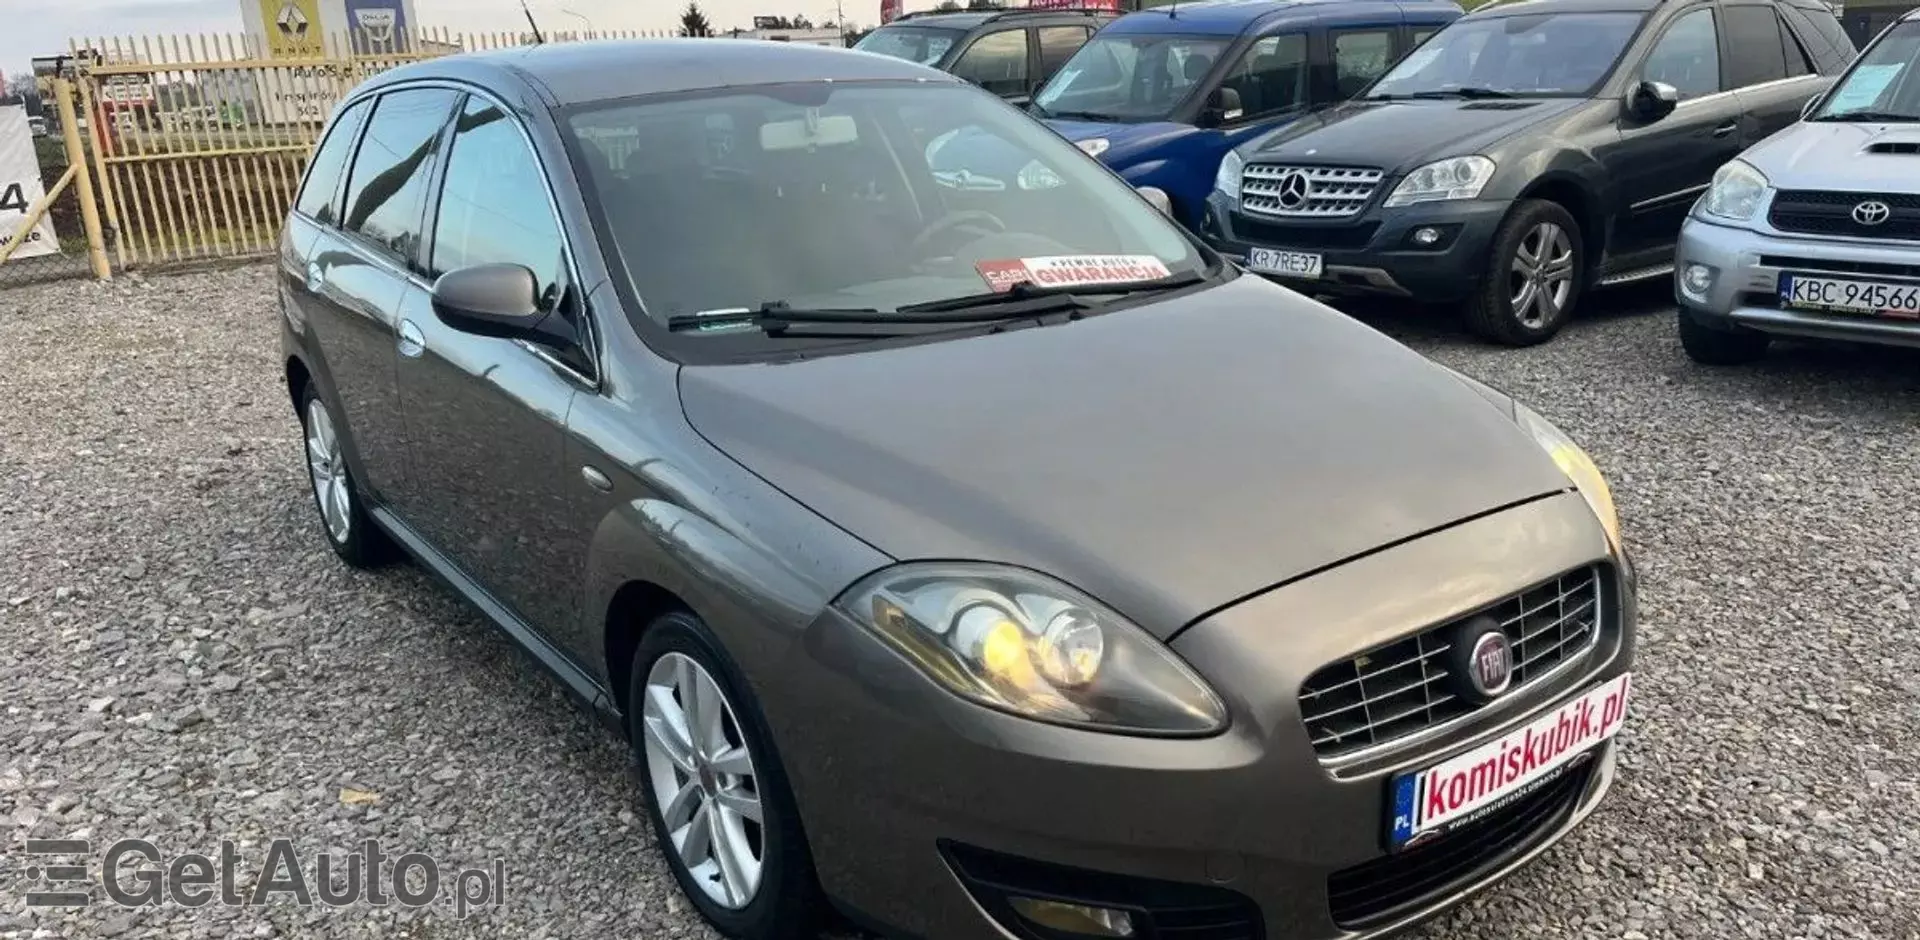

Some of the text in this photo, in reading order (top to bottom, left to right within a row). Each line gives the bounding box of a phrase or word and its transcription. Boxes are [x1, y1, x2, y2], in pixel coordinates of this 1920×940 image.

[1034, 264, 1168, 285] GWARANCJA
[1252, 249, 1318, 273] KR 7RE37
[1791, 279, 1837, 304] KBC
[1844, 283, 1919, 311] 94566
[1481, 647, 1506, 682] FIAT
[1427, 676, 1628, 821] komiskubik.pl
[1394, 813, 1411, 831] PL
